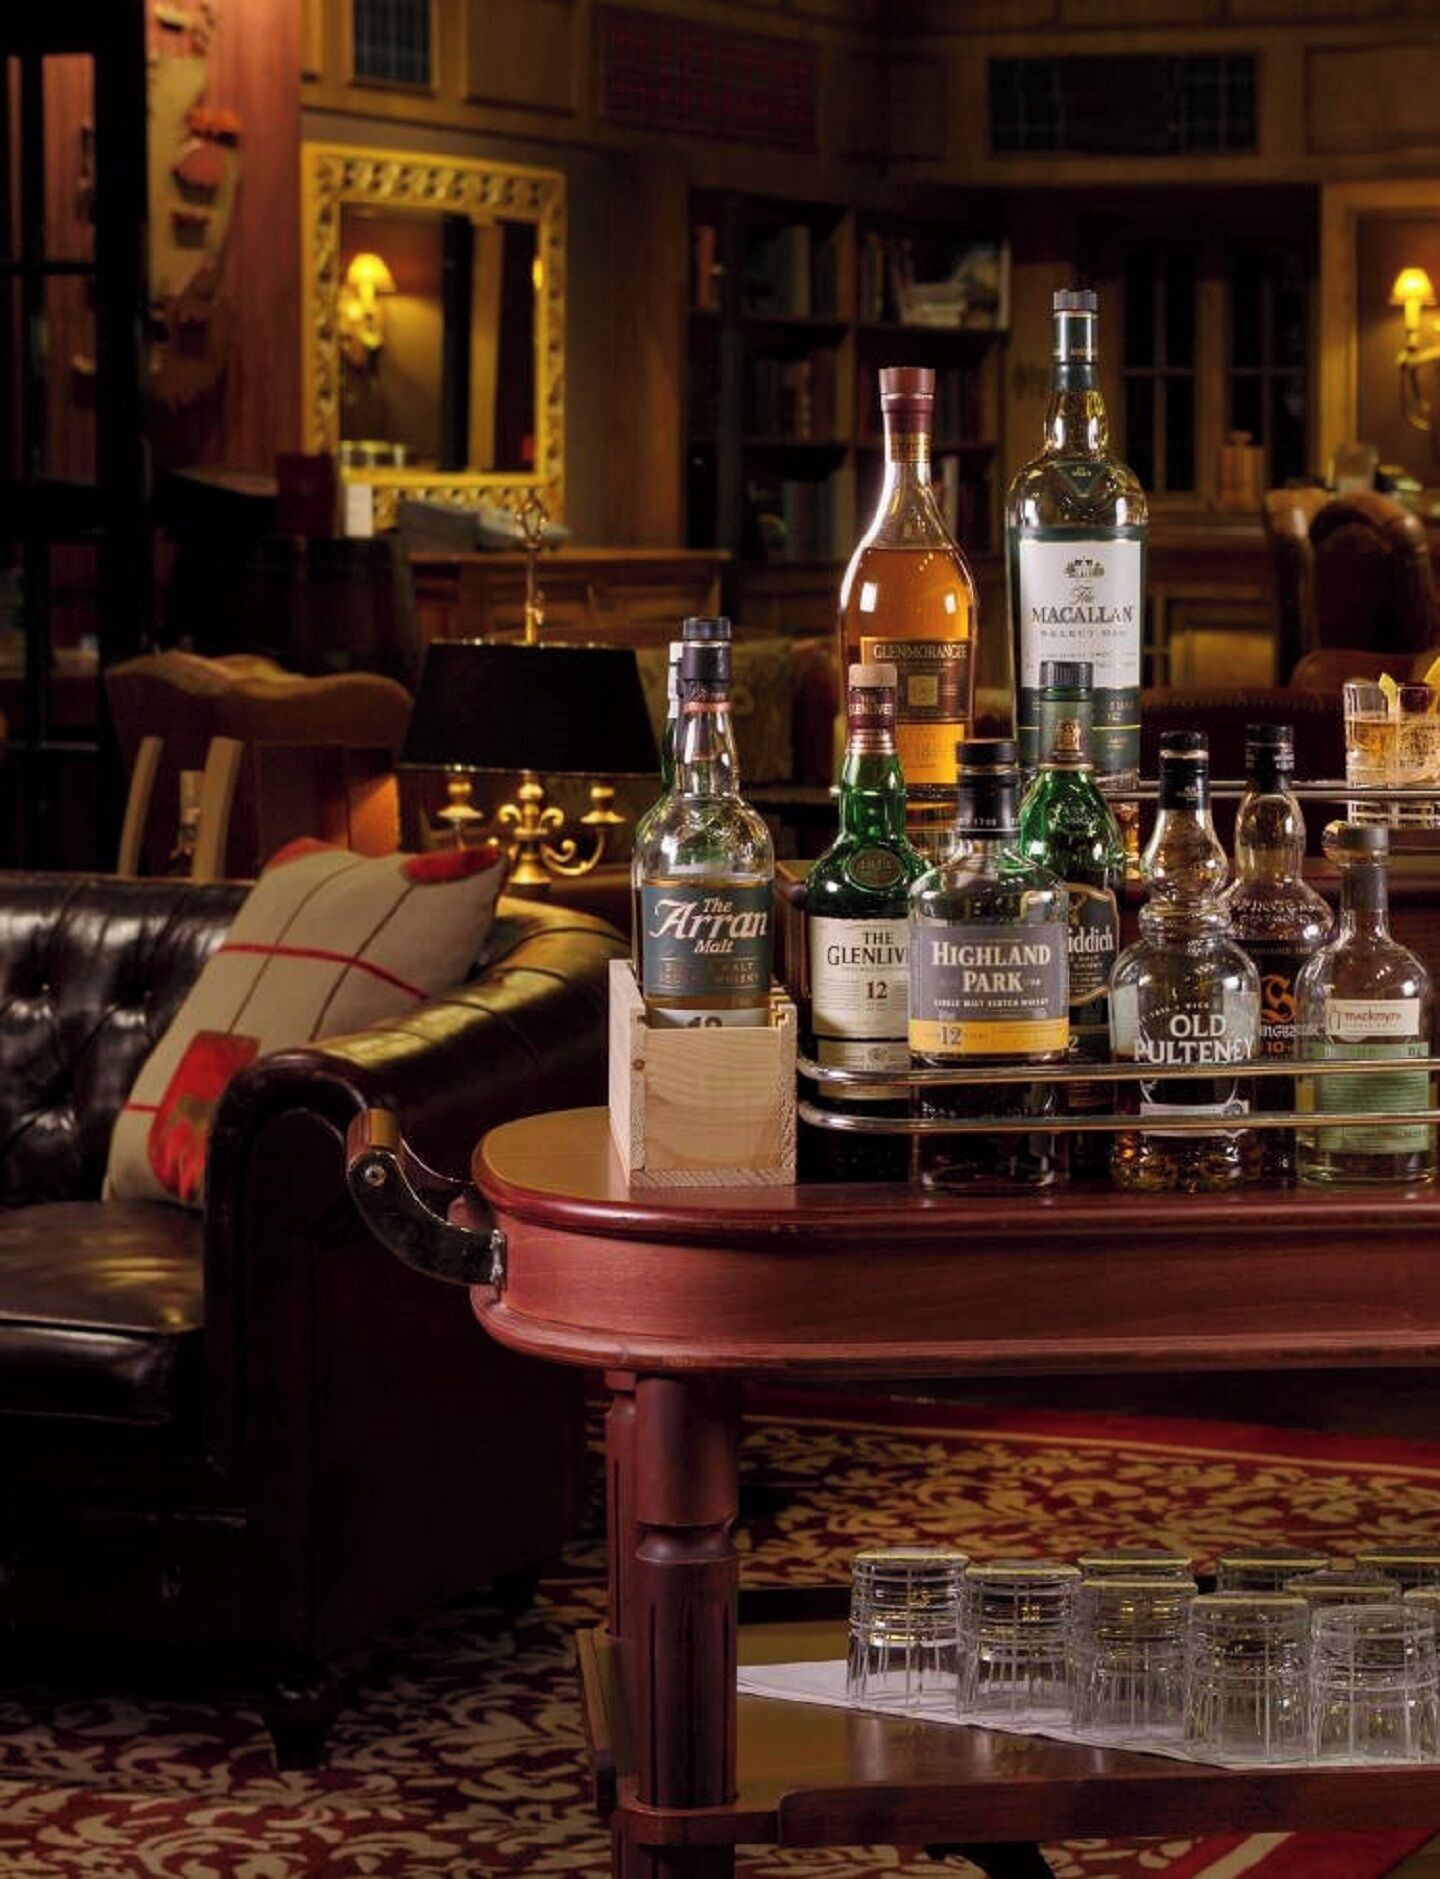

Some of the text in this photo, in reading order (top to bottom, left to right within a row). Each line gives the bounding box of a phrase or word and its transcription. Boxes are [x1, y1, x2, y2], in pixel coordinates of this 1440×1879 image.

[1032, 606, 1133, 623] MACALLAN
[703, 897, 733, 913] The
[649, 898, 768, 940] Arran
[694, 939, 735, 953] Malt
[863, 932, 894, 945] THE
[827, 945, 908, 966] GLENLIV
[931, 941, 1051, 967] HIGHLAND
[866, 981, 888, 999] 12
[962, 970, 1023, 993] PARK
[1169, 1013, 1227, 1037] OLD
[940, 1026, 962, 1045] 12
[1134, 1037, 1254, 1064] PULTENEY
